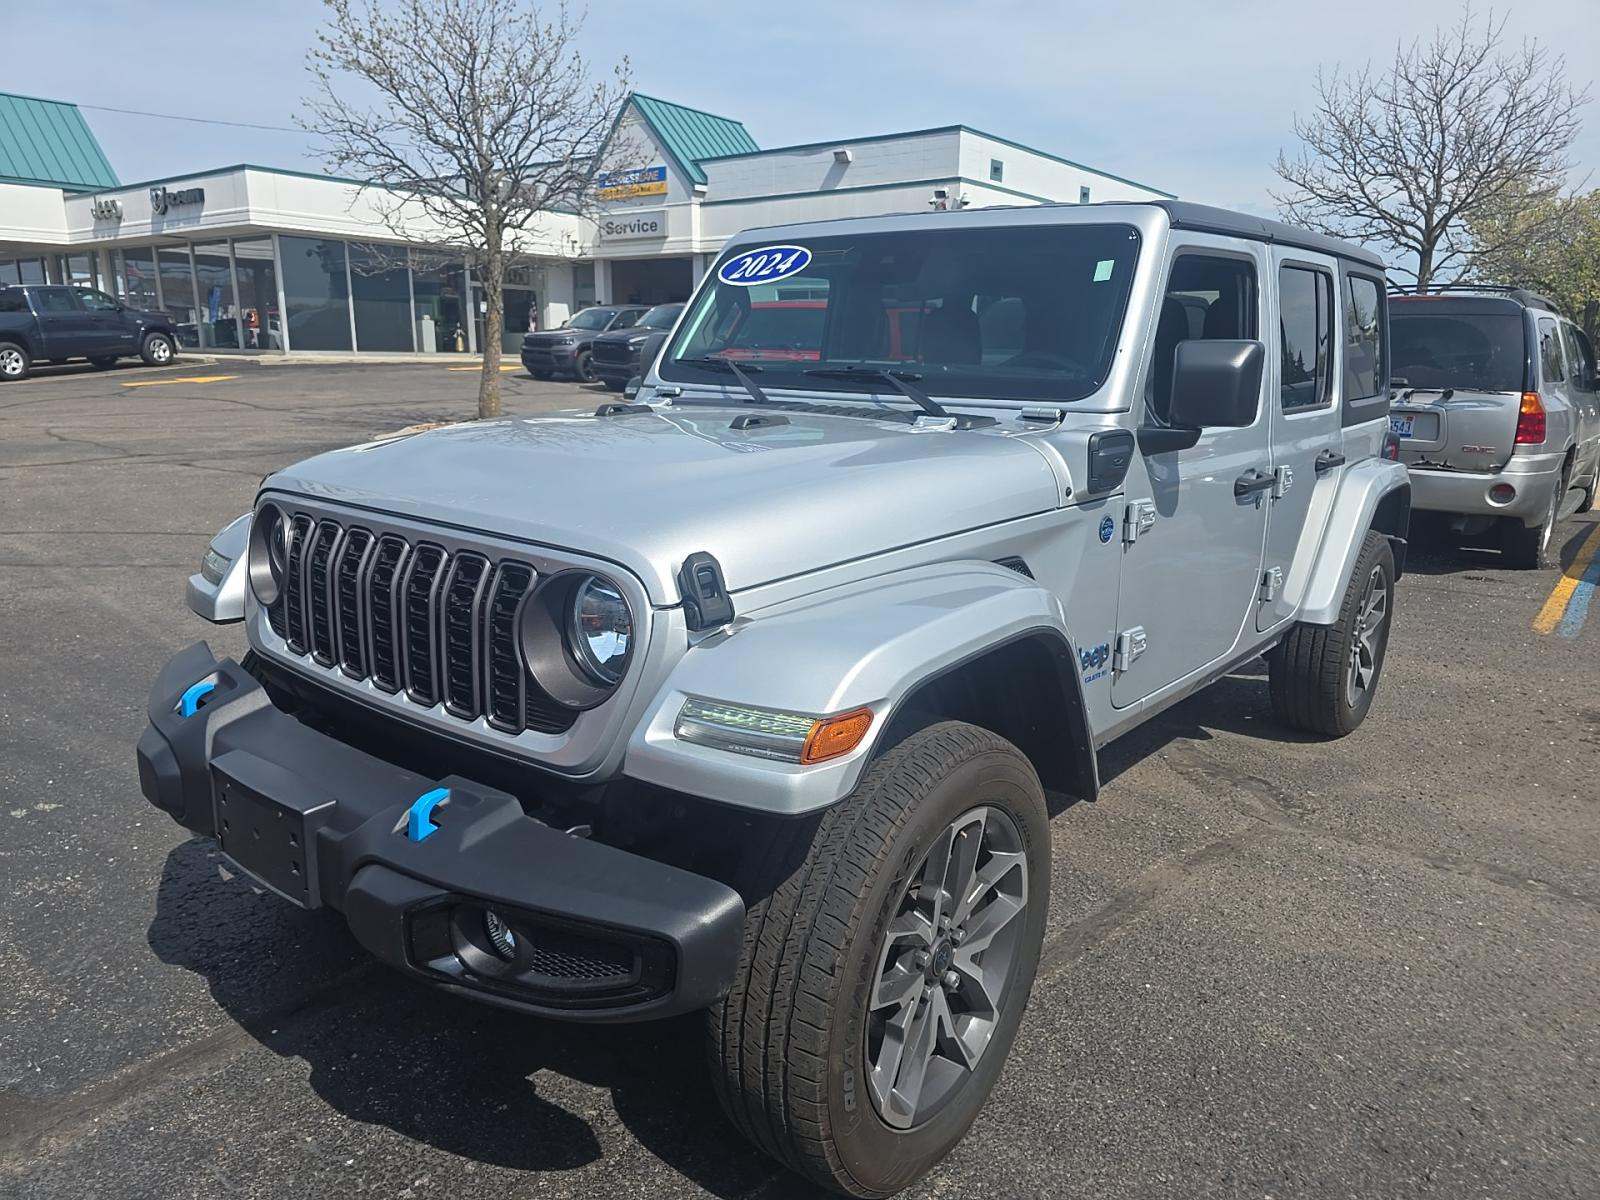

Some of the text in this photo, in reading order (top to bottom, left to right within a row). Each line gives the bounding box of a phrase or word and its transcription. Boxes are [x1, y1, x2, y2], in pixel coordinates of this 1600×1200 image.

[605, 219, 658, 235] Service
[727, 250, 803, 280] 2024
[1462, 444, 1497, 455] GMC
